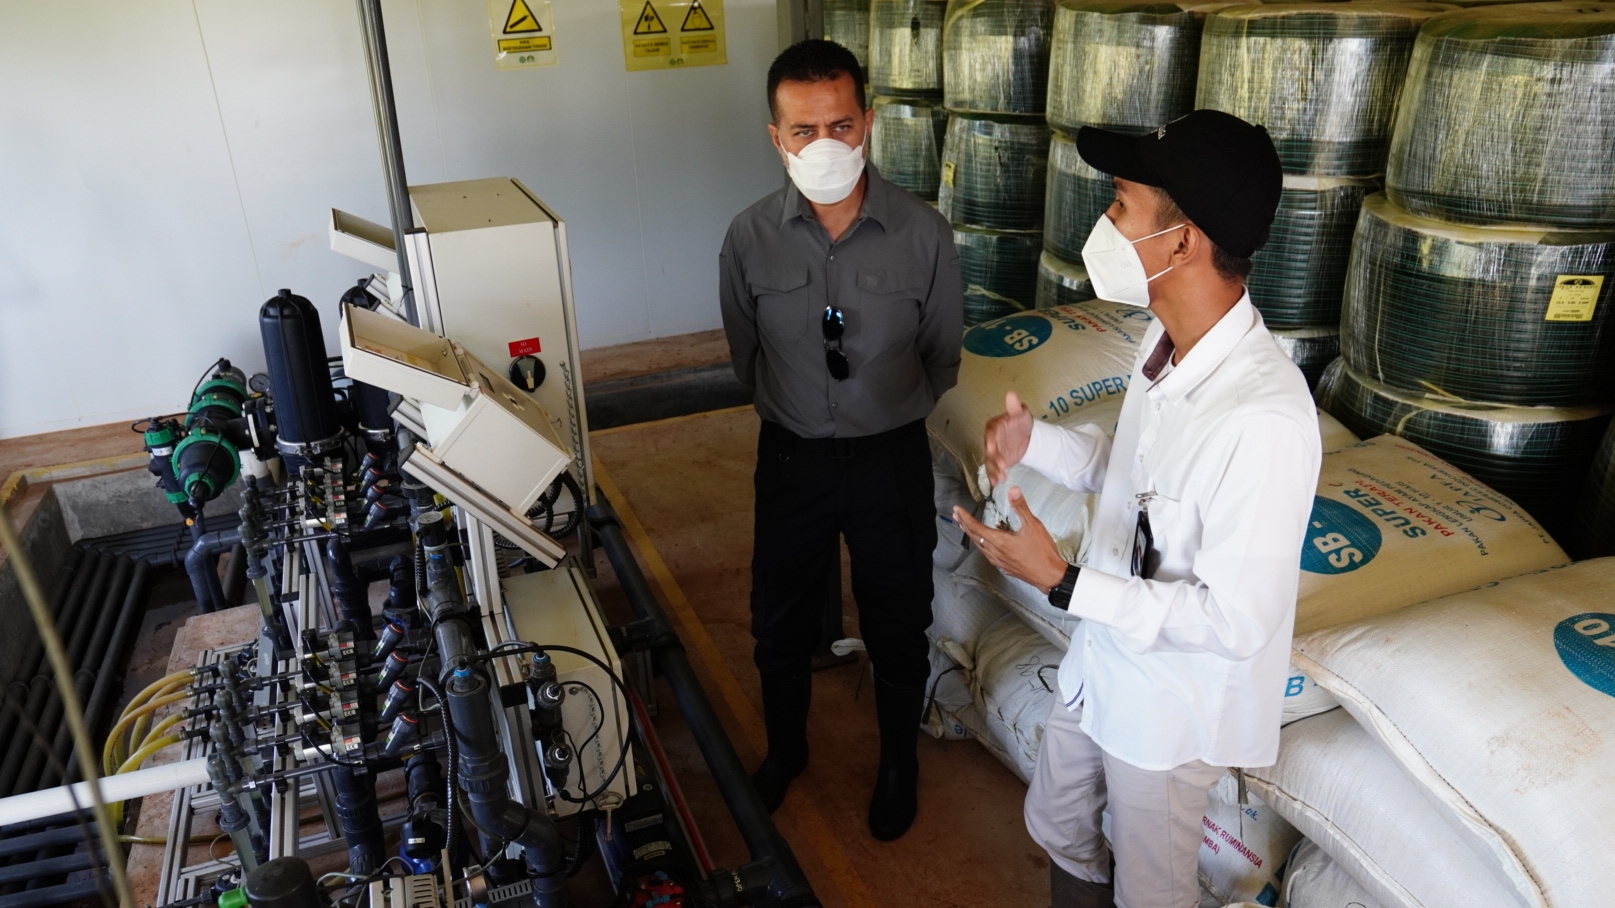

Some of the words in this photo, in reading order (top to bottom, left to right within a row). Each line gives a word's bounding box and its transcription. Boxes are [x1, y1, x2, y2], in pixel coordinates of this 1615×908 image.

[1069, 376, 1127, 407] SUPER
[1355, 480, 1404, 508] TERAPI
[1343, 488, 1427, 538] SUPER
[1403, 506, 1455, 537] PAKAN
[1417, 502, 1464, 528] LENGKAP
[1461, 527, 1489, 557] PAKAN
[1220, 830, 1263, 868] RUMINANSIA
